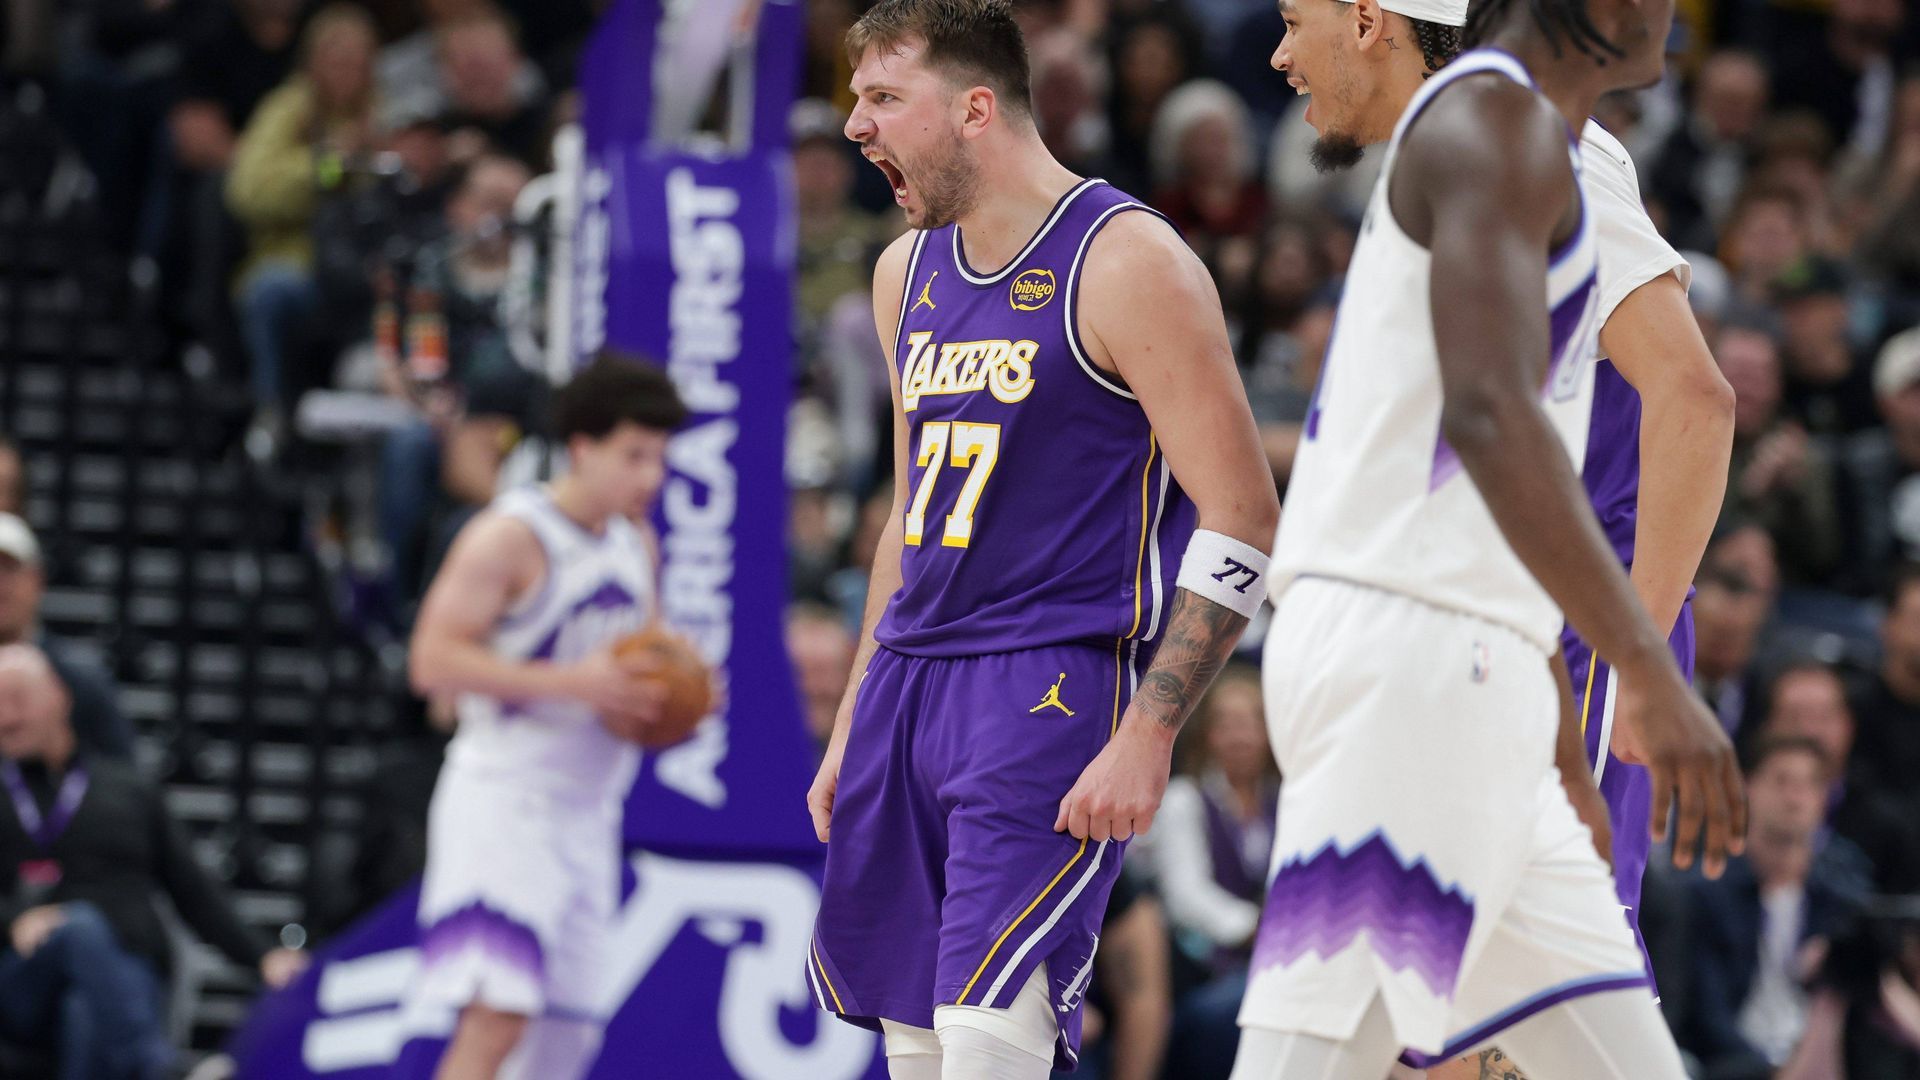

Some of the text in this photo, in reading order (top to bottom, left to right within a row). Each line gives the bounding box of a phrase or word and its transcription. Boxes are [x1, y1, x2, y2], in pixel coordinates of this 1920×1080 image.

[666, 167, 744, 413] FIRST
[1014, 280, 1053, 299] bibigo
[902, 331, 1040, 413] LAKERS
[904, 421, 1001, 548] 77
[1211, 557, 1260, 594] 77
